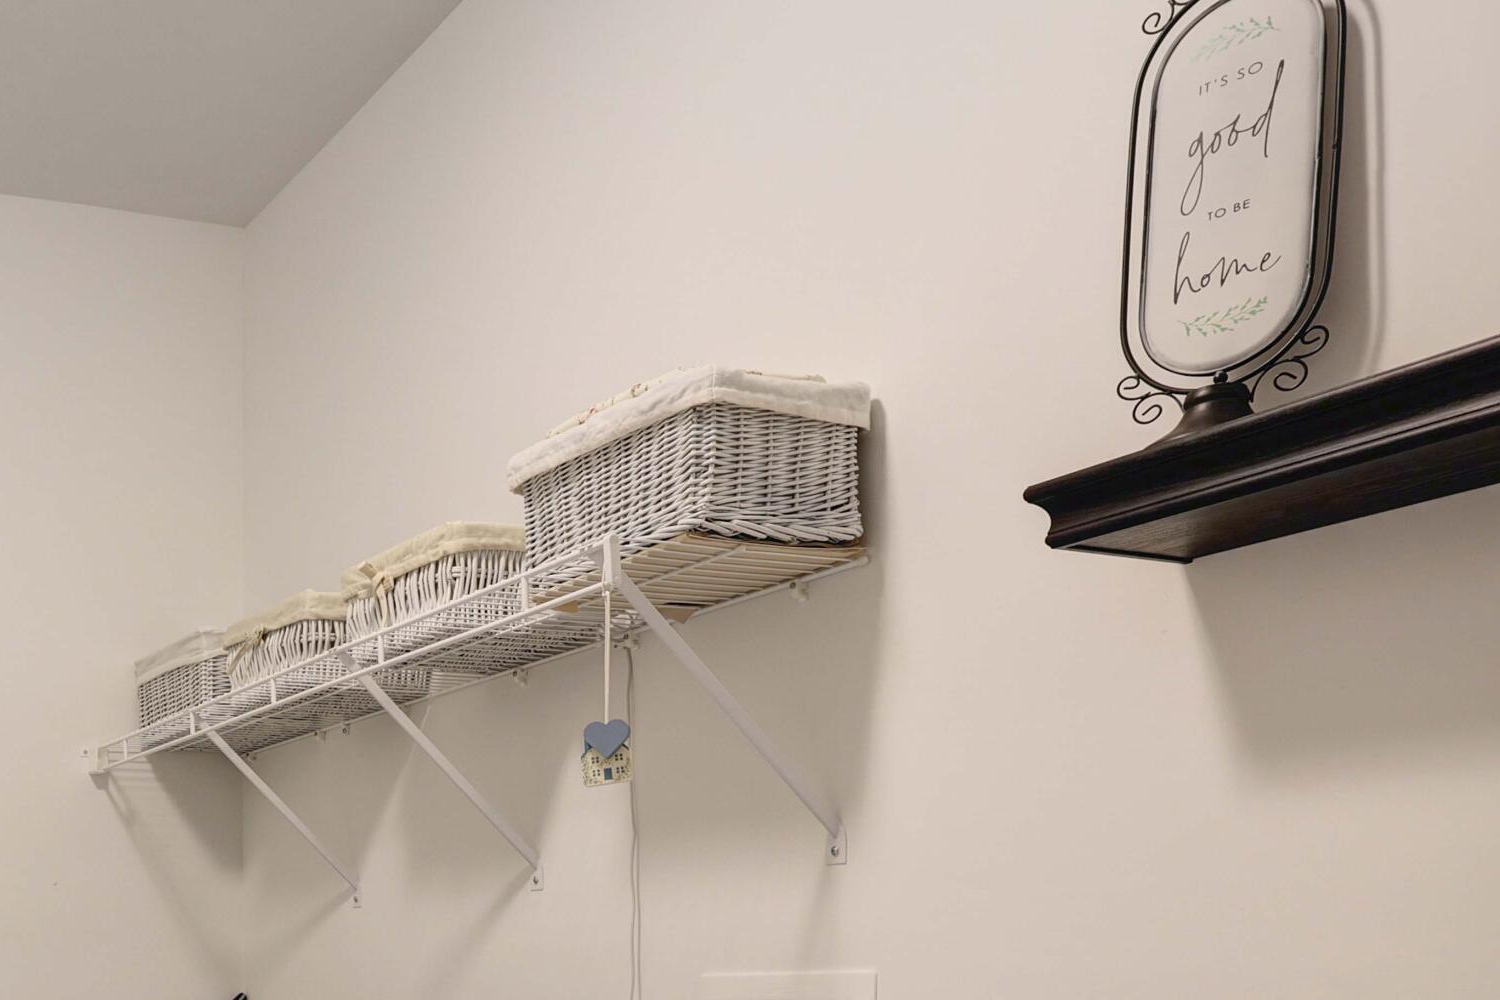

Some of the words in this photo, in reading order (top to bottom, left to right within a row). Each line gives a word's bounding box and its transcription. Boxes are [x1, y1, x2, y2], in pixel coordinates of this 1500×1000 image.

[1198, 75, 1229, 96] IT'S
[1235, 61, 1263, 80] SO
[1180, 58, 1285, 217] good
[1207, 207, 1227, 221] TO
[1233, 198, 1252, 214] BE
[1173, 231, 1282, 304] home
